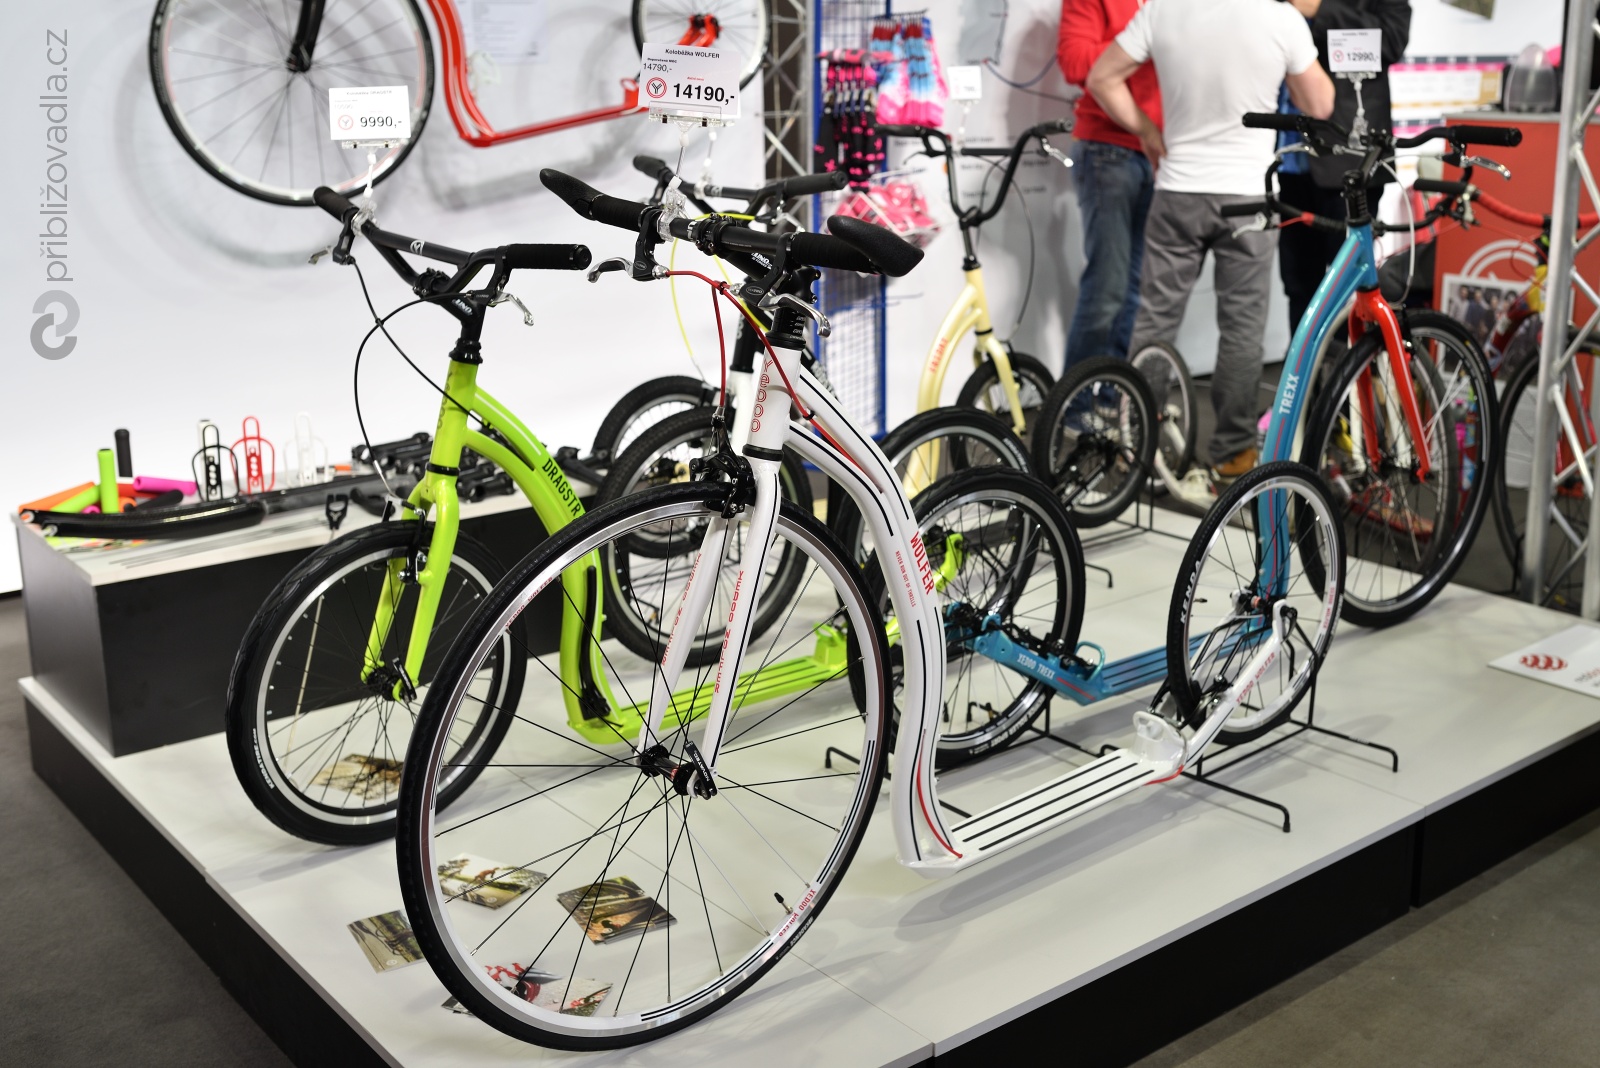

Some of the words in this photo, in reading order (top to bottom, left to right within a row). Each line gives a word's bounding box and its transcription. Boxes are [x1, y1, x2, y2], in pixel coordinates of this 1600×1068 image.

[643, 63, 672, 73] 14790,-
[665, 48, 694, 57] Koloběžka
[695, 51, 720, 59] WOLFER
[673, 83, 735, 105] 14190,-
[360, 116, 402, 128] 9990,-
[1279, 373, 1299, 414] TREXX
[541, 458, 582, 516] DRAGSTR
[910, 531, 935, 595] WOLFER
[728, 570, 744, 622] YEDOO
[1180, 560, 1201, 624] KENDA
[714, 629, 731, 693] WOLFER
[1017, 652, 1036, 670] YEDOO
[1036, 663, 1056, 679] TREXX
[1235, 680, 1255, 703] YEDOO
[1255, 652, 1276, 680] WOLFER
[798, 889, 816, 911] YEDOO
